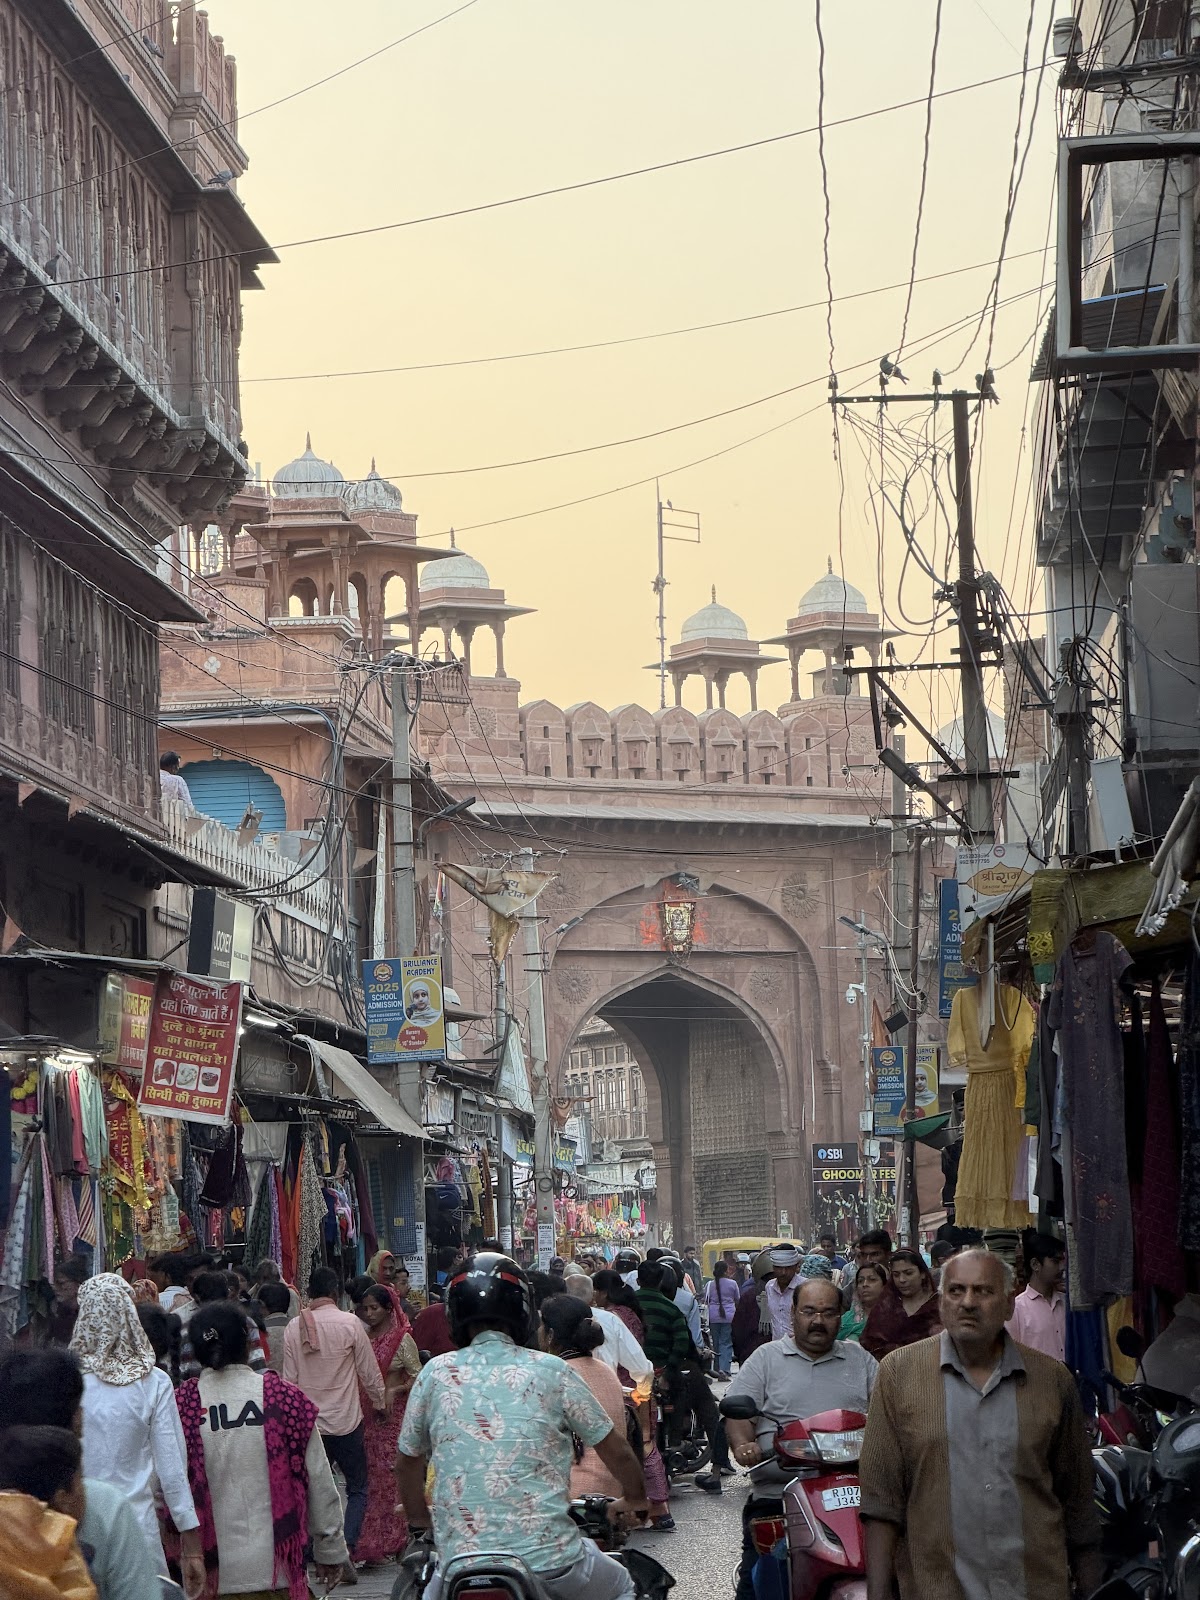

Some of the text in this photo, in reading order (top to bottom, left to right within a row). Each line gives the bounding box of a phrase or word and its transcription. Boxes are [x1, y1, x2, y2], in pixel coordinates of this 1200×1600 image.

[403, 958, 438, 968] BRILLIANCE
[406, 967, 435, 976] ACADEMY
[368, 982, 399, 993] 2025
[371, 993, 398, 1001] SCHOOL
[180, 999, 199, 1016] लिए
[367, 1000, 403, 1009] ADMISSION
[167, 1035, 181, 1045] का
[876, 1067, 901, 1075] 2025
[175, 1091, 190, 1104] की
[192, 1096, 224, 1109] दुकान
[827, 1148, 843, 1160] SBI
[822, 1169, 877, 1180] GHOOMR
[832, 1486, 860, 1498] RJ07
